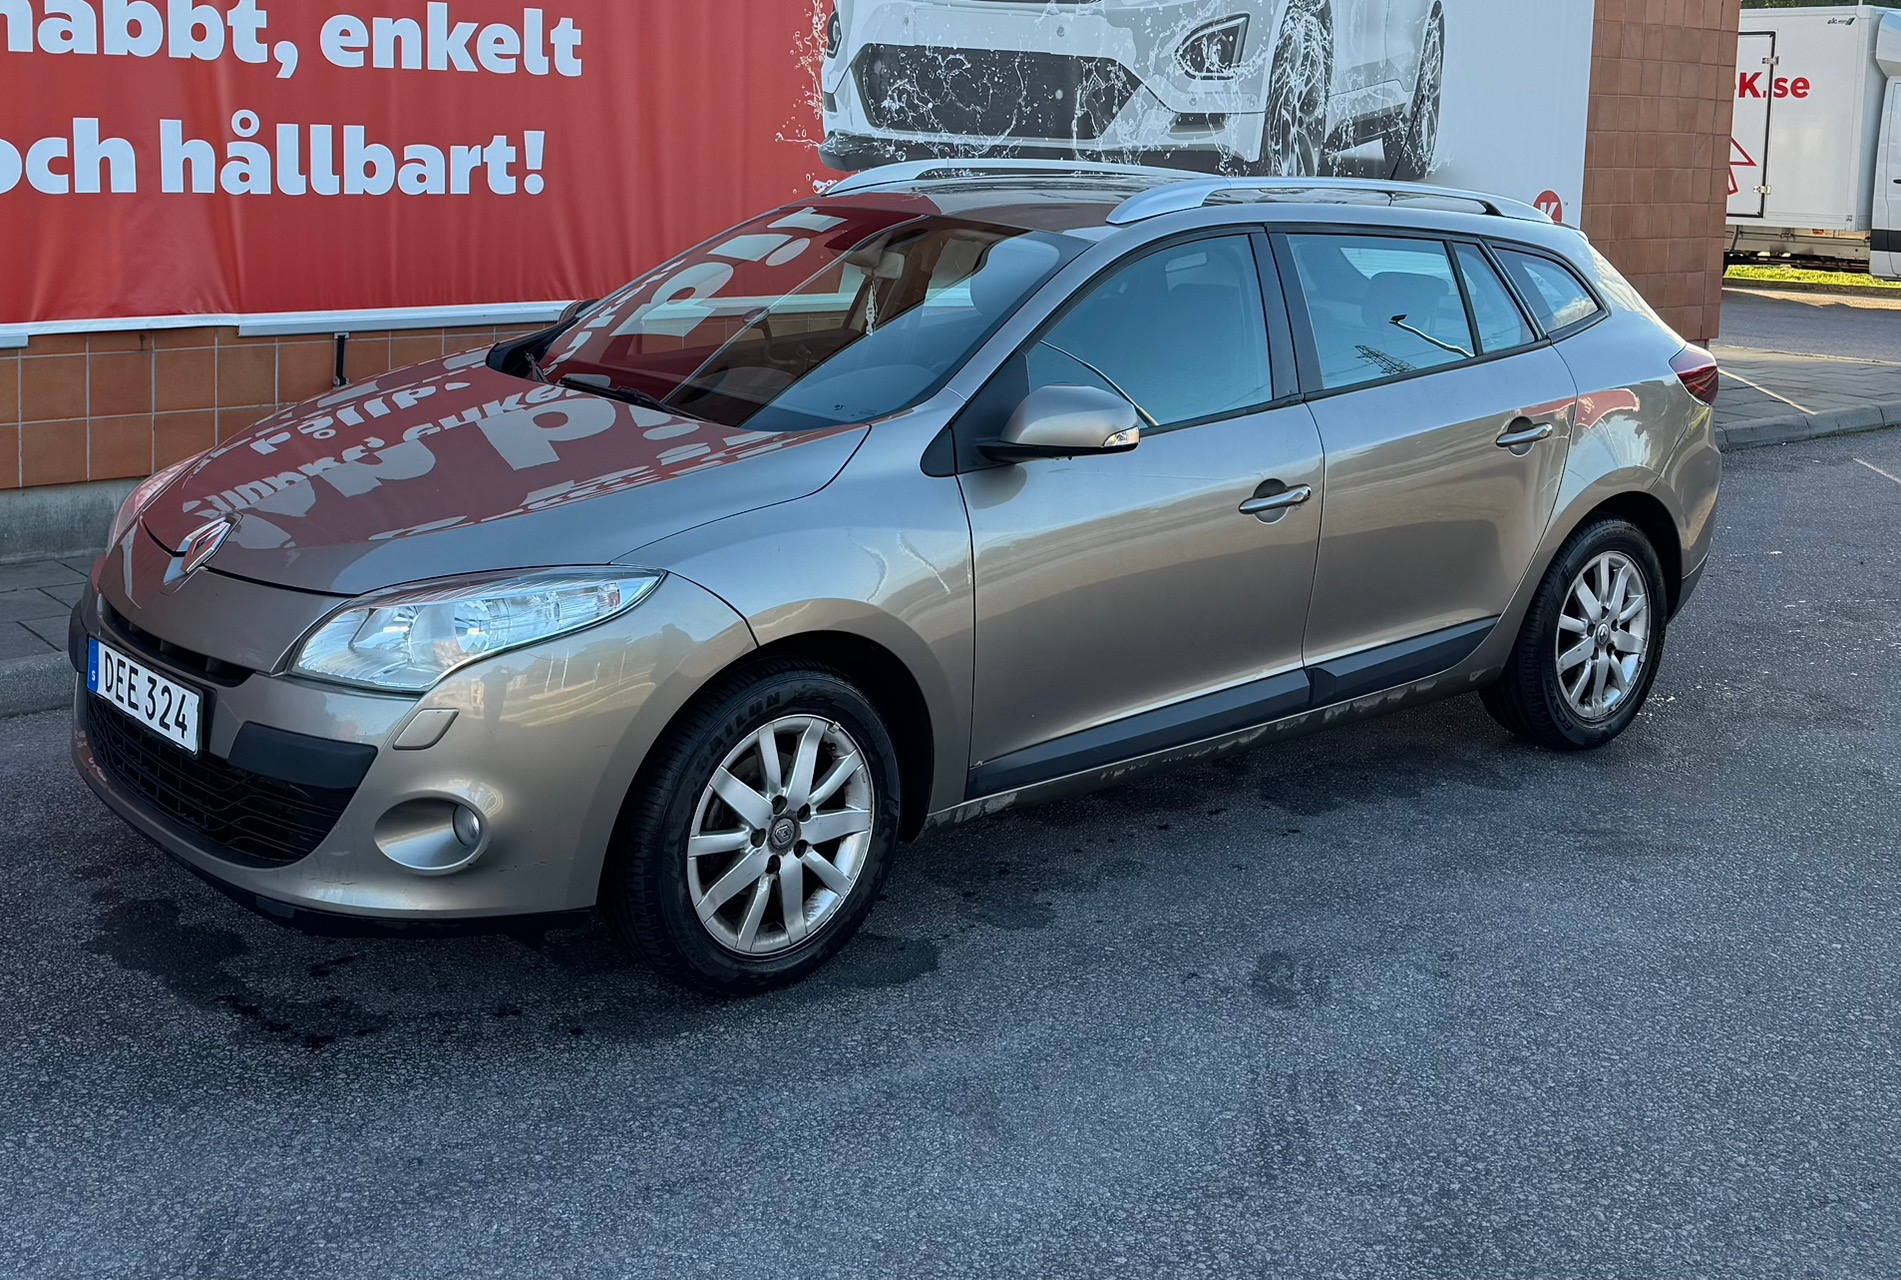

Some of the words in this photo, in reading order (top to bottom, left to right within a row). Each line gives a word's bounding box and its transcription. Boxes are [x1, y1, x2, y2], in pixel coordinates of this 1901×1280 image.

[320, 2, 582, 77] enkelt
[160, 110, 545, 196] hållbart!
[90, 669, 97, 682] S
[105, 650, 139, 711] DEE
[145, 675, 188, 740] 324
